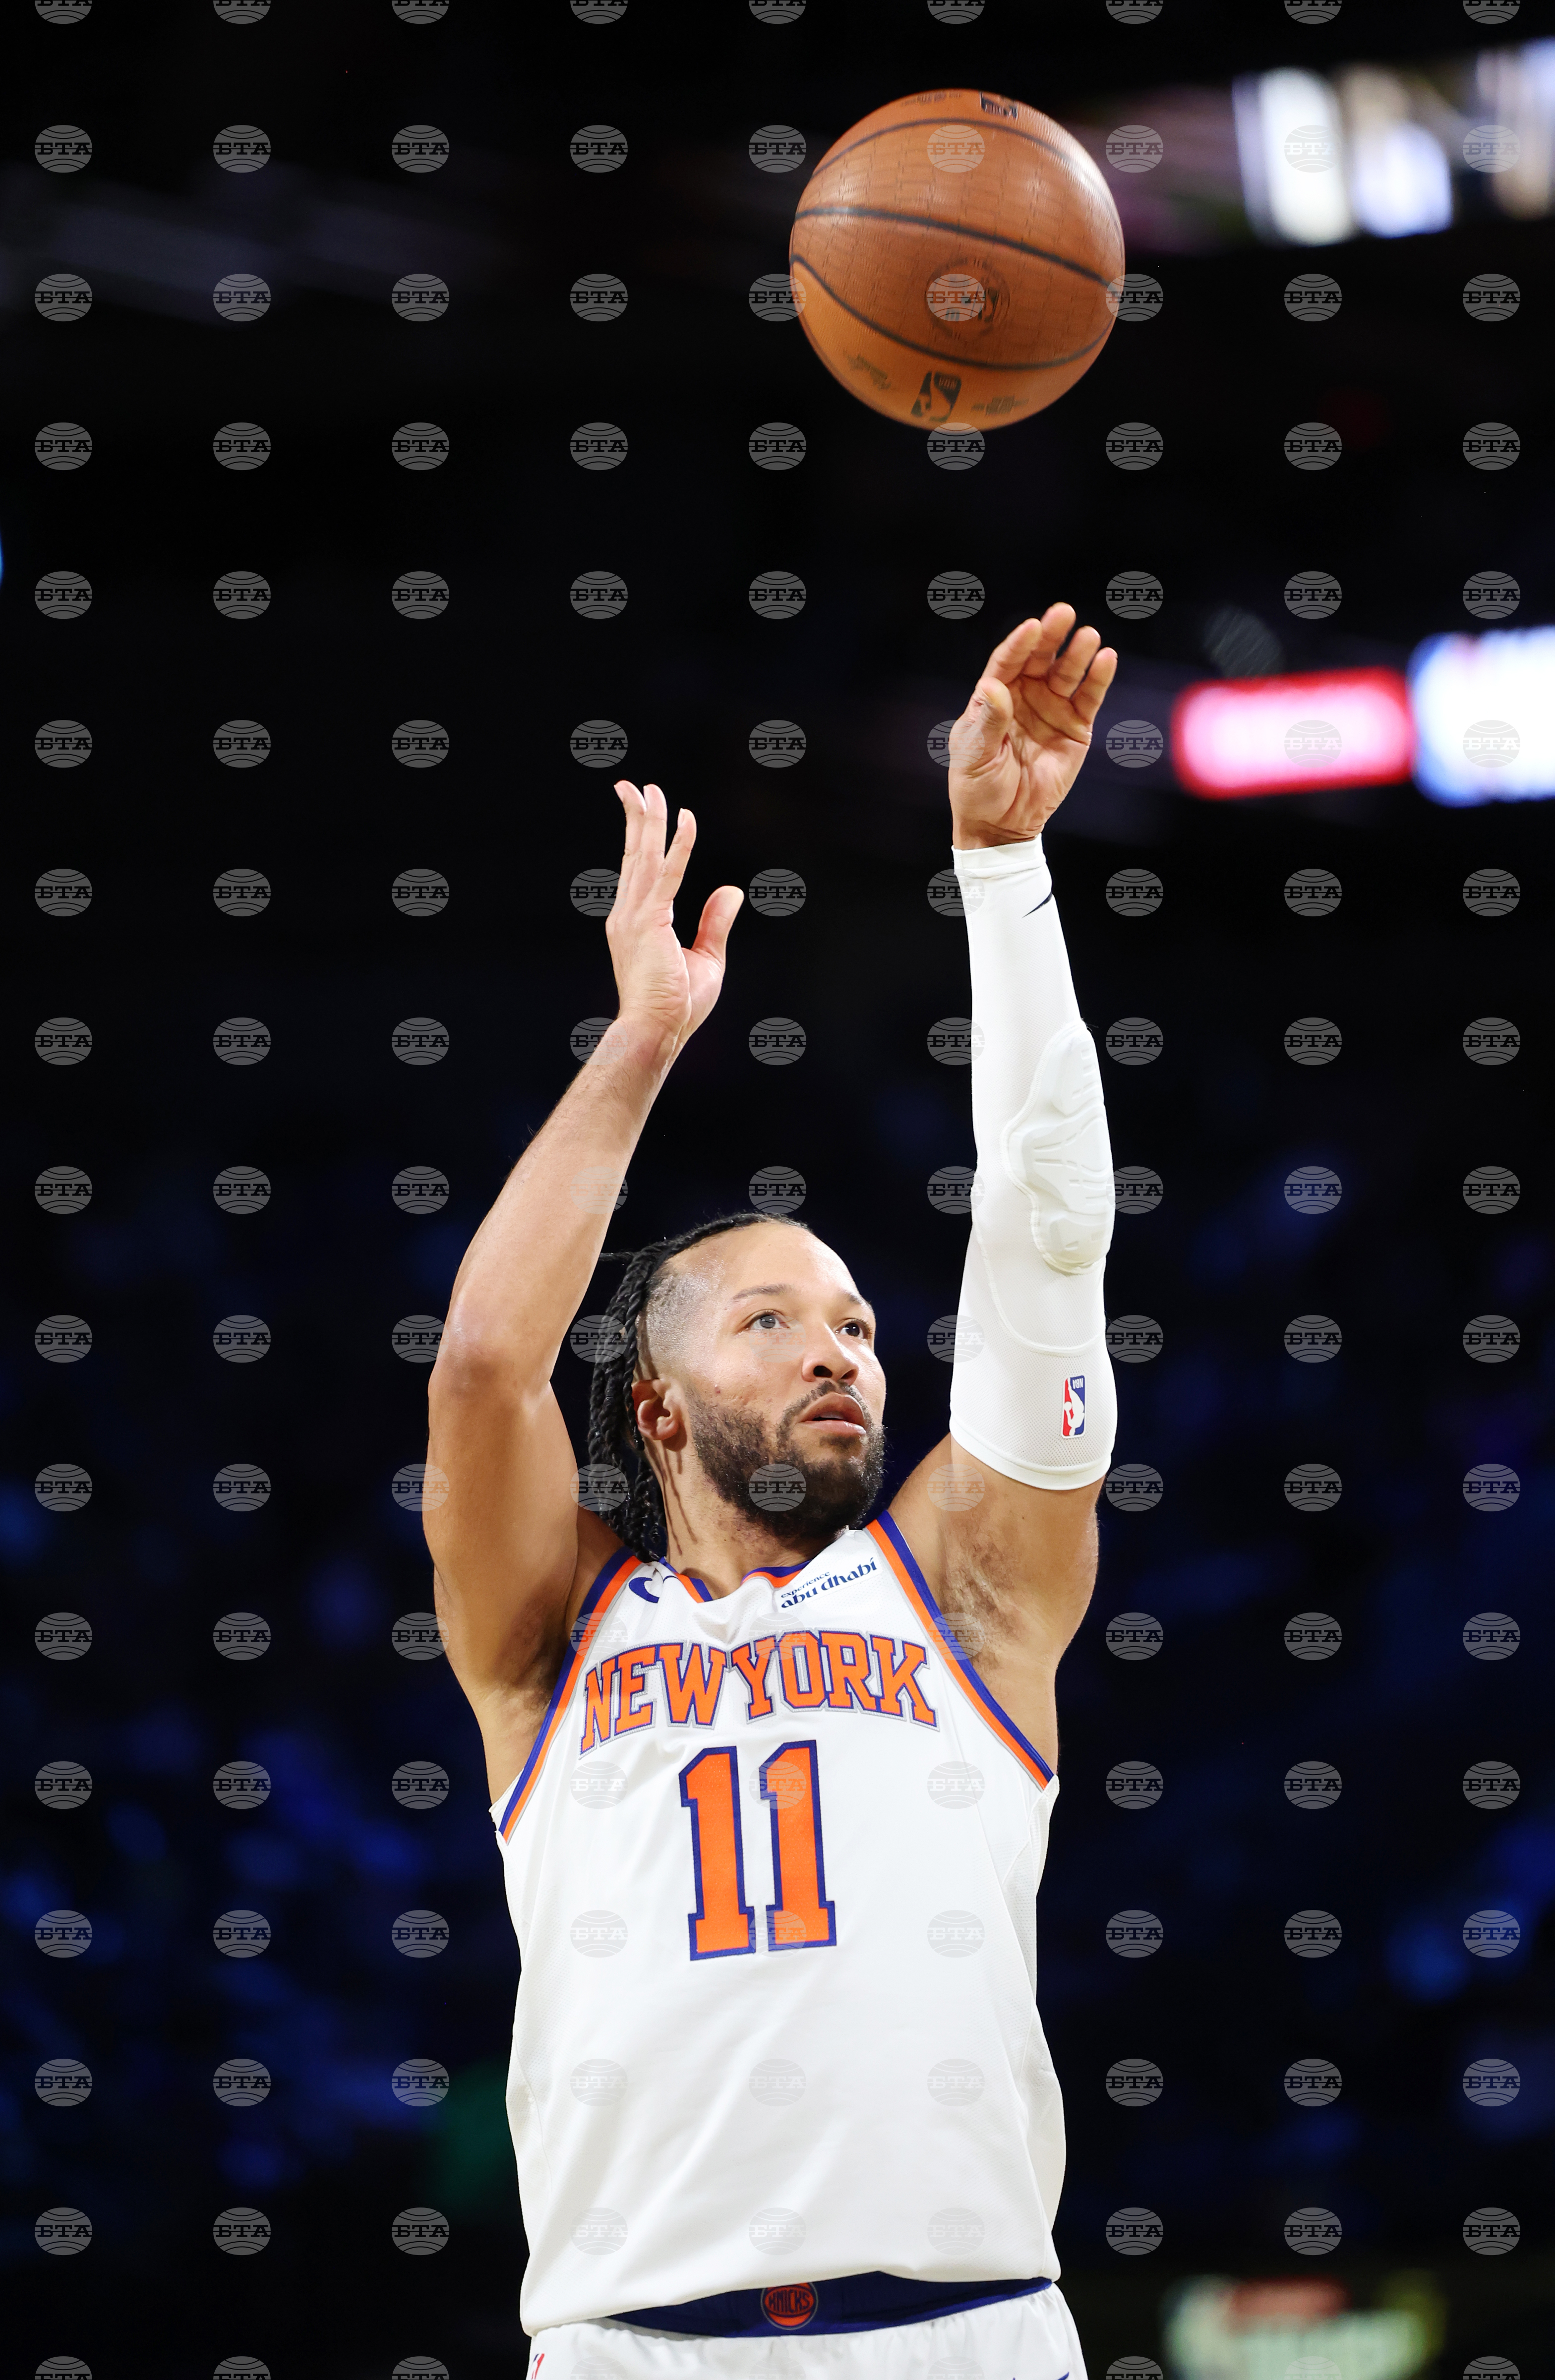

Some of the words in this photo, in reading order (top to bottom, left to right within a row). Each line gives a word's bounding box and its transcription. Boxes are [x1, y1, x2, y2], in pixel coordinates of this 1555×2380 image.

[1073, 1377, 1083, 1389] NBA
[781, 1572, 830, 1598] experience
[781, 1587, 818, 1608] abu
[679, 1740, 837, 1961] 11
[768, 2289, 810, 2313] KNICKS
